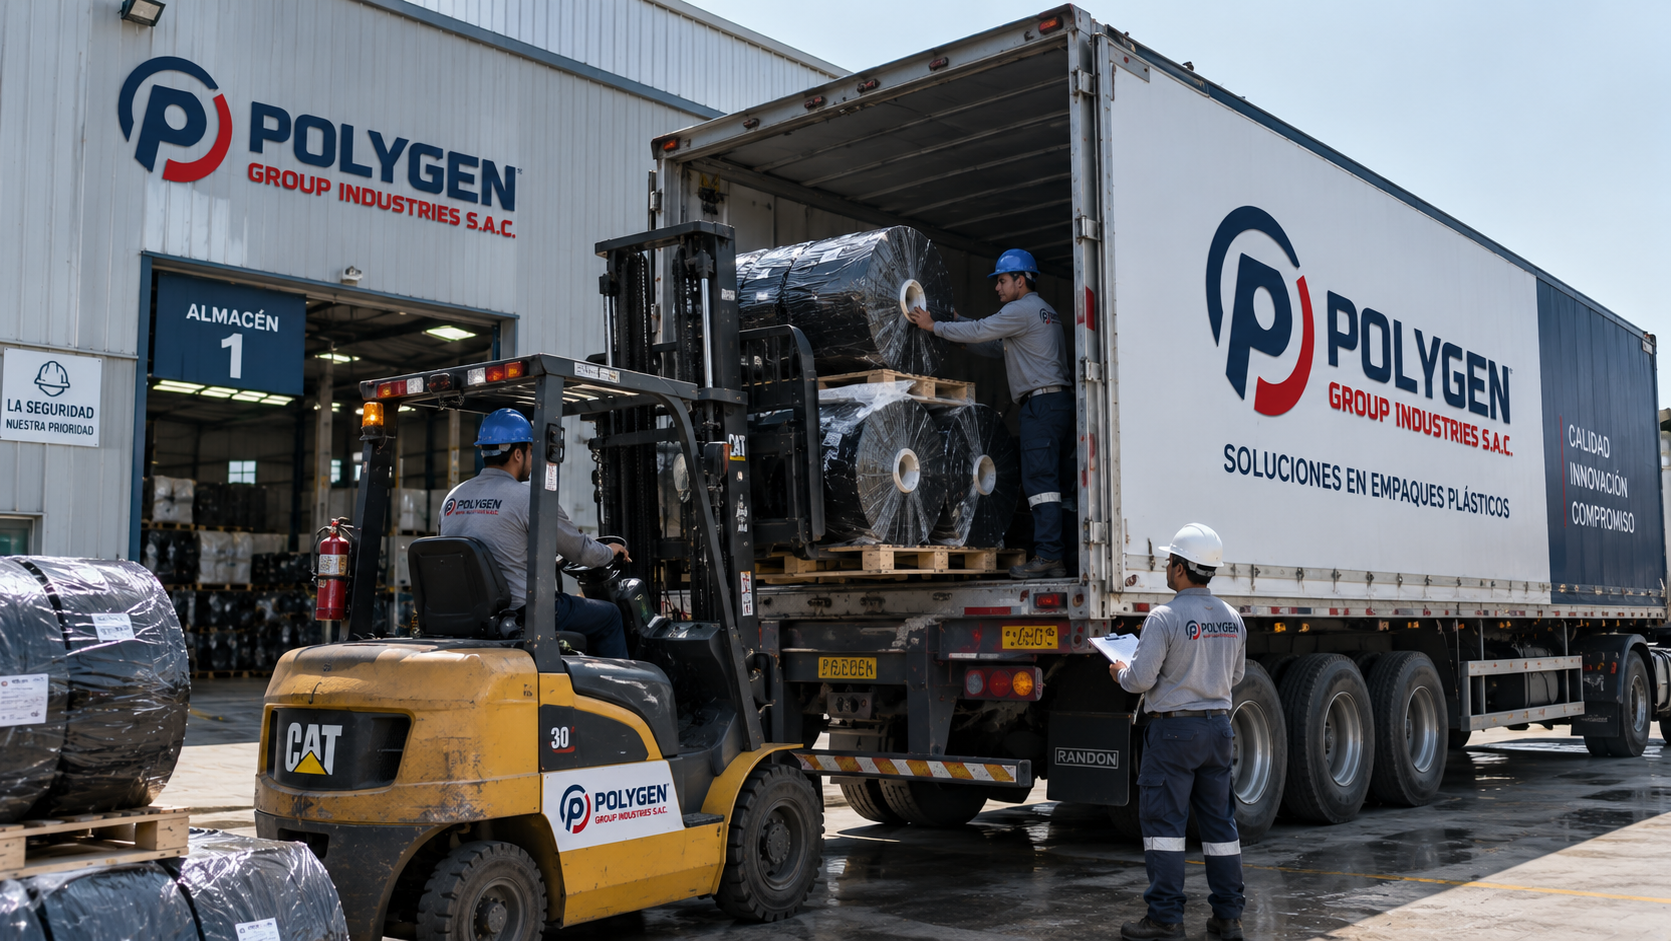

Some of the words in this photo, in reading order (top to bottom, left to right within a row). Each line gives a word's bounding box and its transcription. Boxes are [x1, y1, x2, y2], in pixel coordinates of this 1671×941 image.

[249, 101, 516, 212] POLYGEN
[248, 162, 332, 197] GROUP
[339, 182, 461, 226] INDUSTRIES
[466, 211, 517, 239] S.A.C.
[186, 303, 279, 333] ALMACÉN
[221, 332, 243, 380] 1
[1327, 289, 1511, 425] POLYGEN
[7, 399, 23, 414] LA
[26, 401, 95, 420] SEGURIDAD
[1328, 381, 1390, 423] GROUP
[1395, 402, 1479, 448] INDUSTRIES
[1482, 428, 1514, 457] S.A.C.
[6, 418, 46, 432] NUESTRA
[49, 421, 94, 436] PRIORIDAD
[1568, 424, 1611, 459] CALIDAD
[1223, 443, 1342, 492] SOLUCIONES
[1346, 467, 1367, 496] EN
[1371, 472, 1445, 509] EMPAQUES
[1448, 485, 1510, 519] PLÁSTICOS
[1569, 461, 1628, 499] INNOVACIÓN
[457, 498, 502, 510] POLYGEN
[1571, 501, 1635, 534] COMPROMISO
[1201, 621, 1239, 634] POLYGEN
[285, 722, 343, 776] CAT
[550, 726, 570, 750] 30
[1057, 750, 1116, 766] RANDON
[595, 783, 667, 813] POLYGEN
